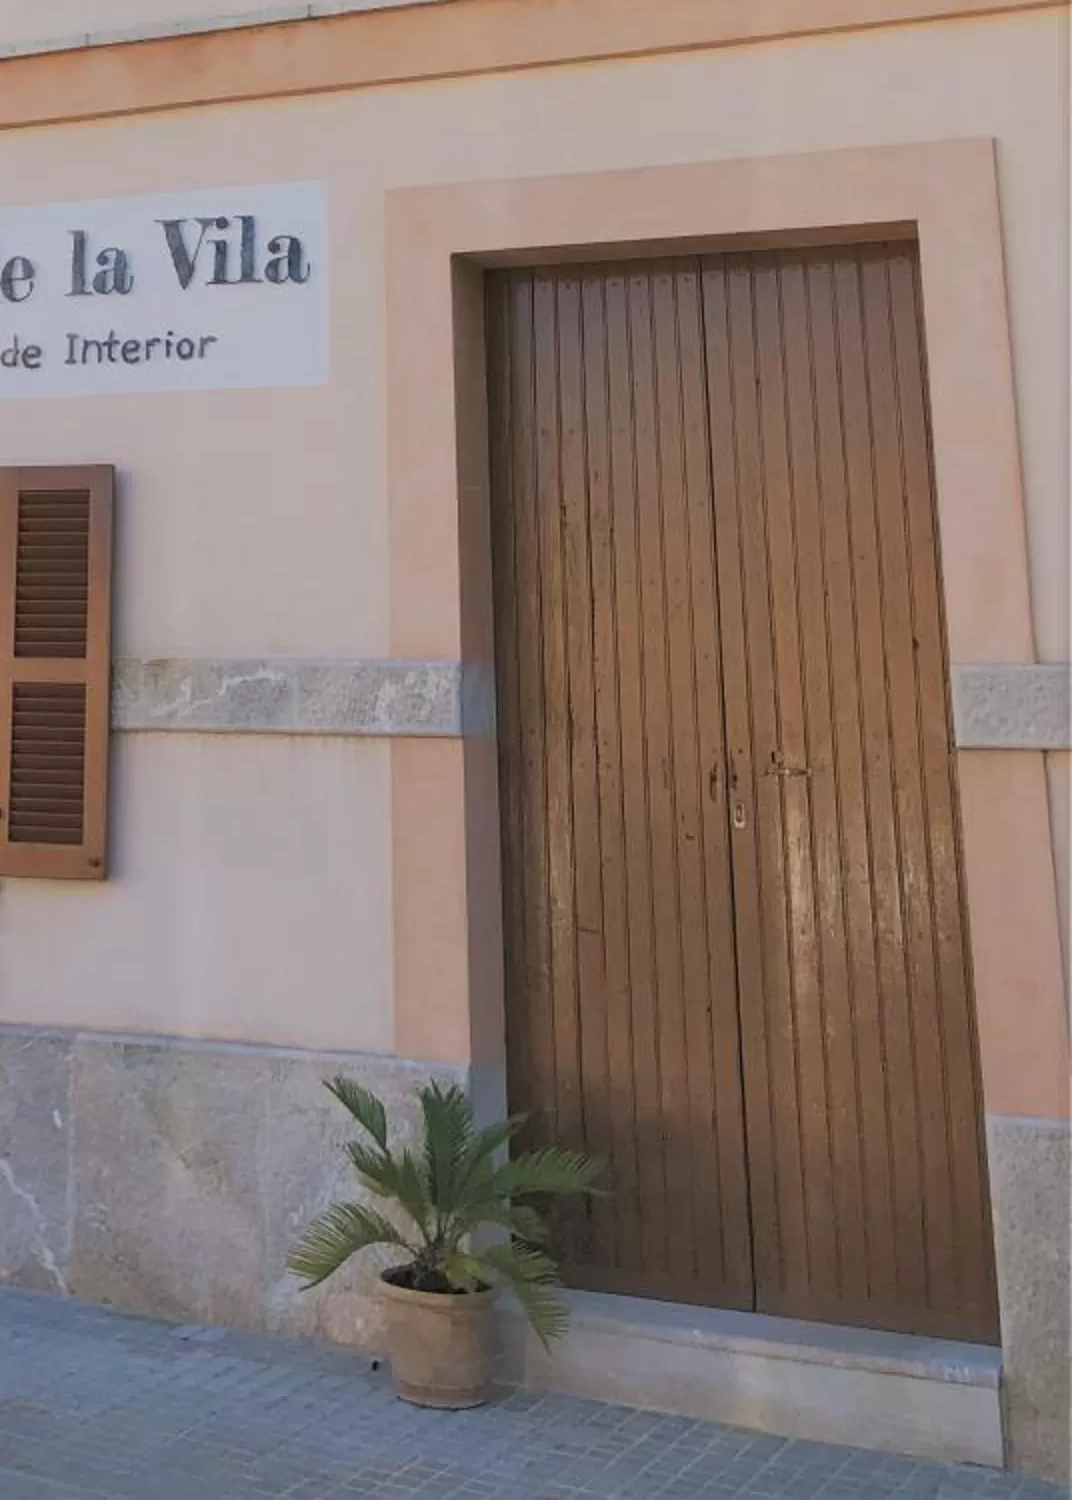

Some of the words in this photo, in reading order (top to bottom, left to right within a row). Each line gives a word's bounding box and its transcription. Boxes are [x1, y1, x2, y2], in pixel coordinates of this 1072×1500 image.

[65, 230, 135, 298] la
[155, 215, 312, 290] Vila
[0, 334, 43, 369] de
[65, 332, 219, 366] Interior
